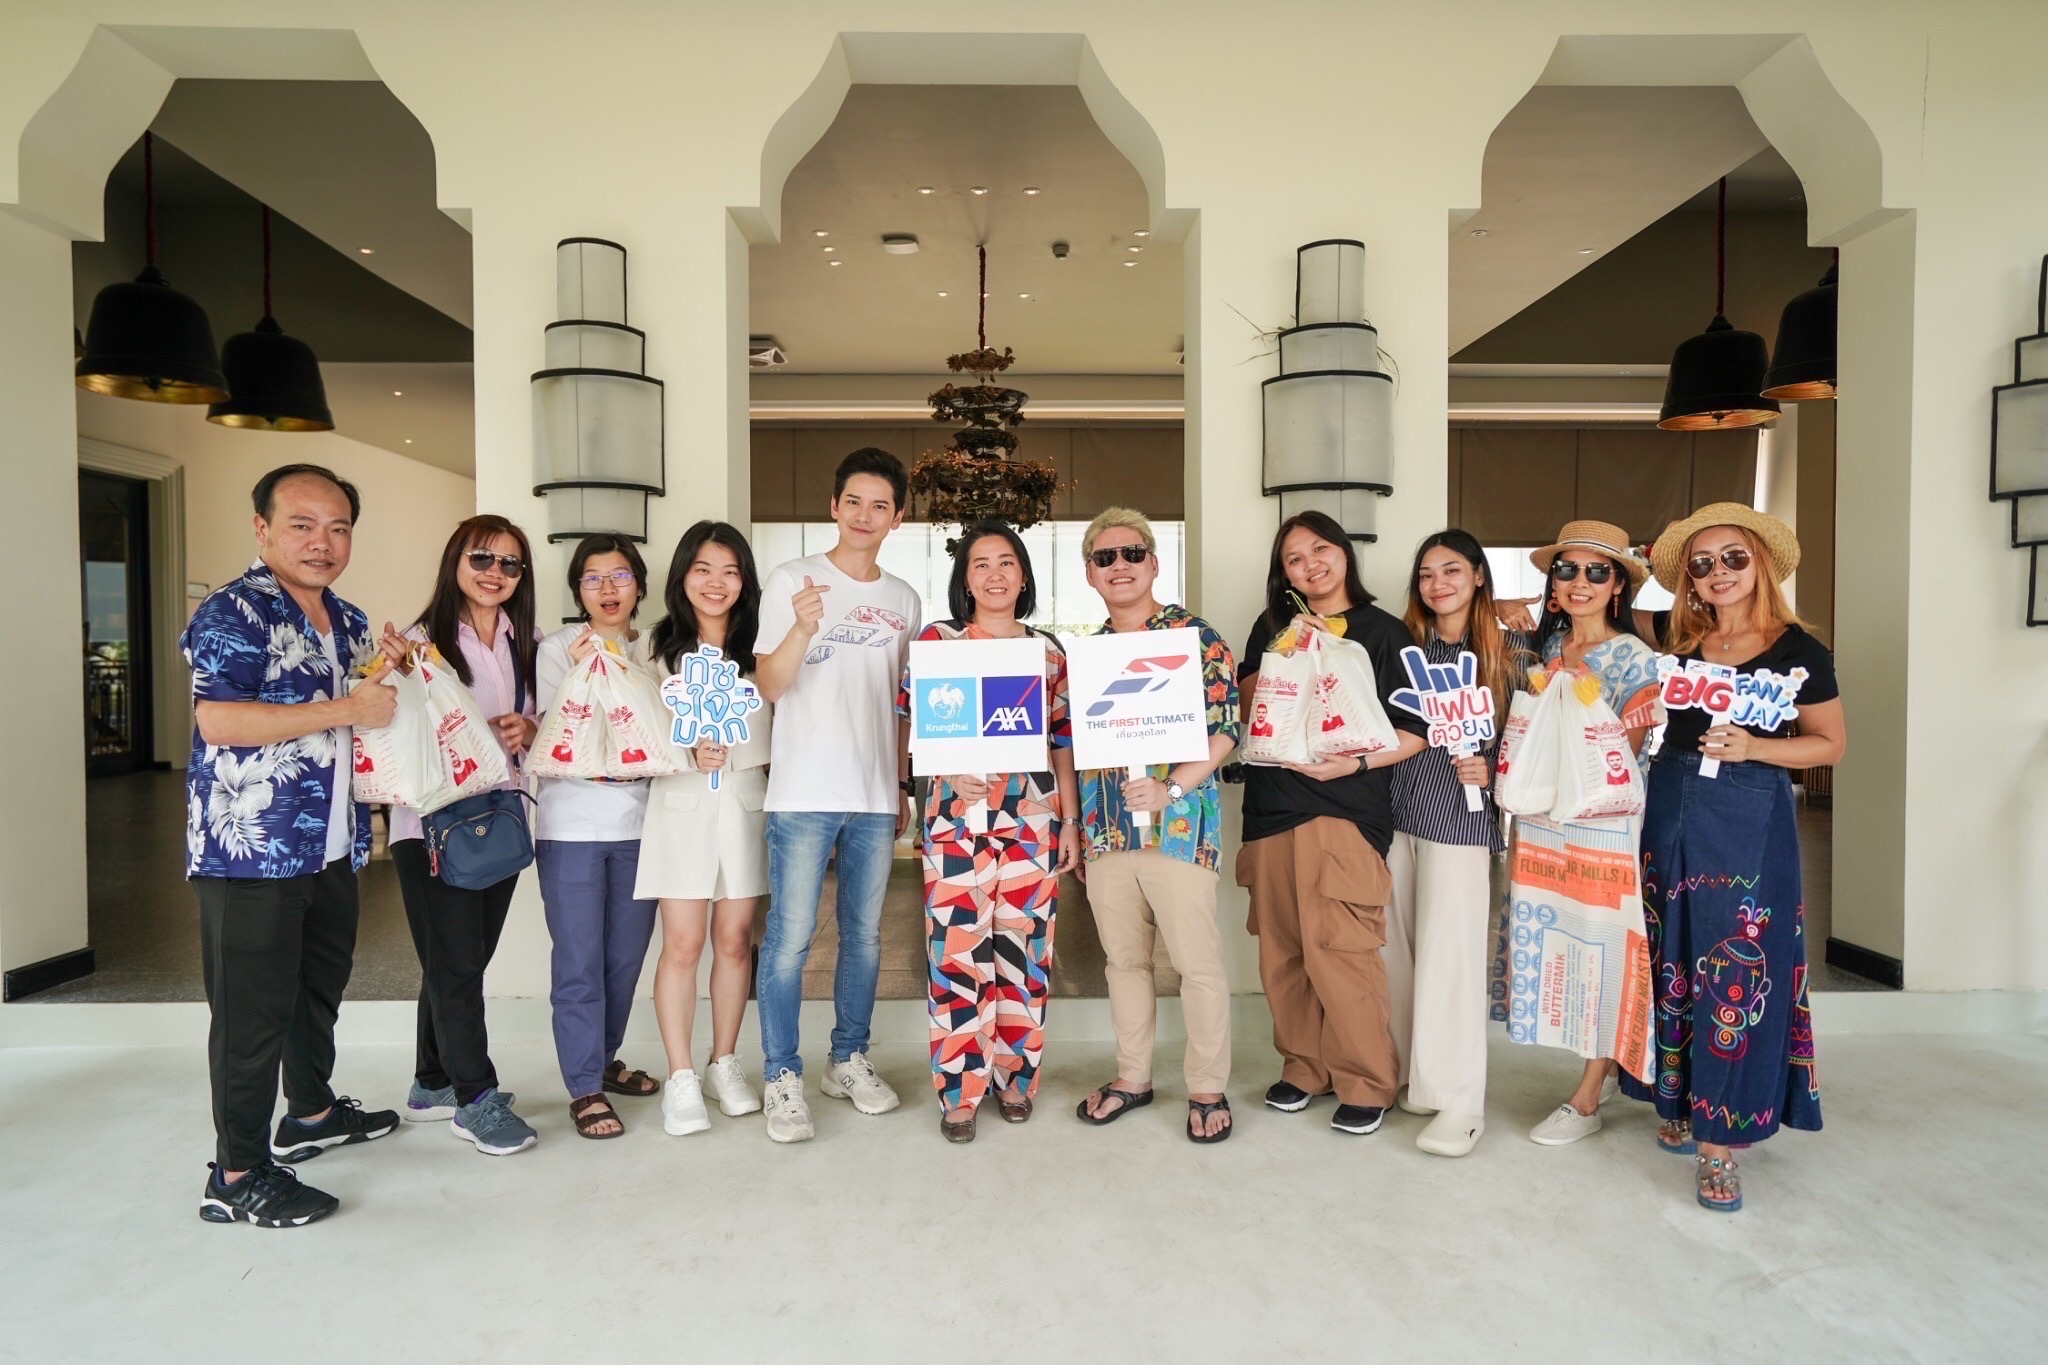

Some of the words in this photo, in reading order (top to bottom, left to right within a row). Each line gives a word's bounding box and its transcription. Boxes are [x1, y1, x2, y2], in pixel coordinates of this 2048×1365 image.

[686, 683, 730, 723] ใจ
[1664, 675, 1734, 712] BIG
[1735, 676, 1783, 703] FAN
[983, 707, 1033, 731] AXA
[1426, 691, 1490, 722] แฟน
[1732, 701, 1781, 728] JAI
[926, 722, 968, 733] Krungthai
[1086, 720, 1107, 729] THE
[1109, 717, 1140, 728] FIRST
[1142, 713, 1195, 725] ULTIMATE
[1116, 728, 1167, 739] เที่ยวสุดโลก
[1582, 863, 1619, 883] MILLS
[1543, 961, 1553, 988] DRIED
[1542, 992, 1550, 1013] WITH
[1631, 999, 1646, 1037] FLOUR
[1627, 1041, 1642, 1072] JUNK
